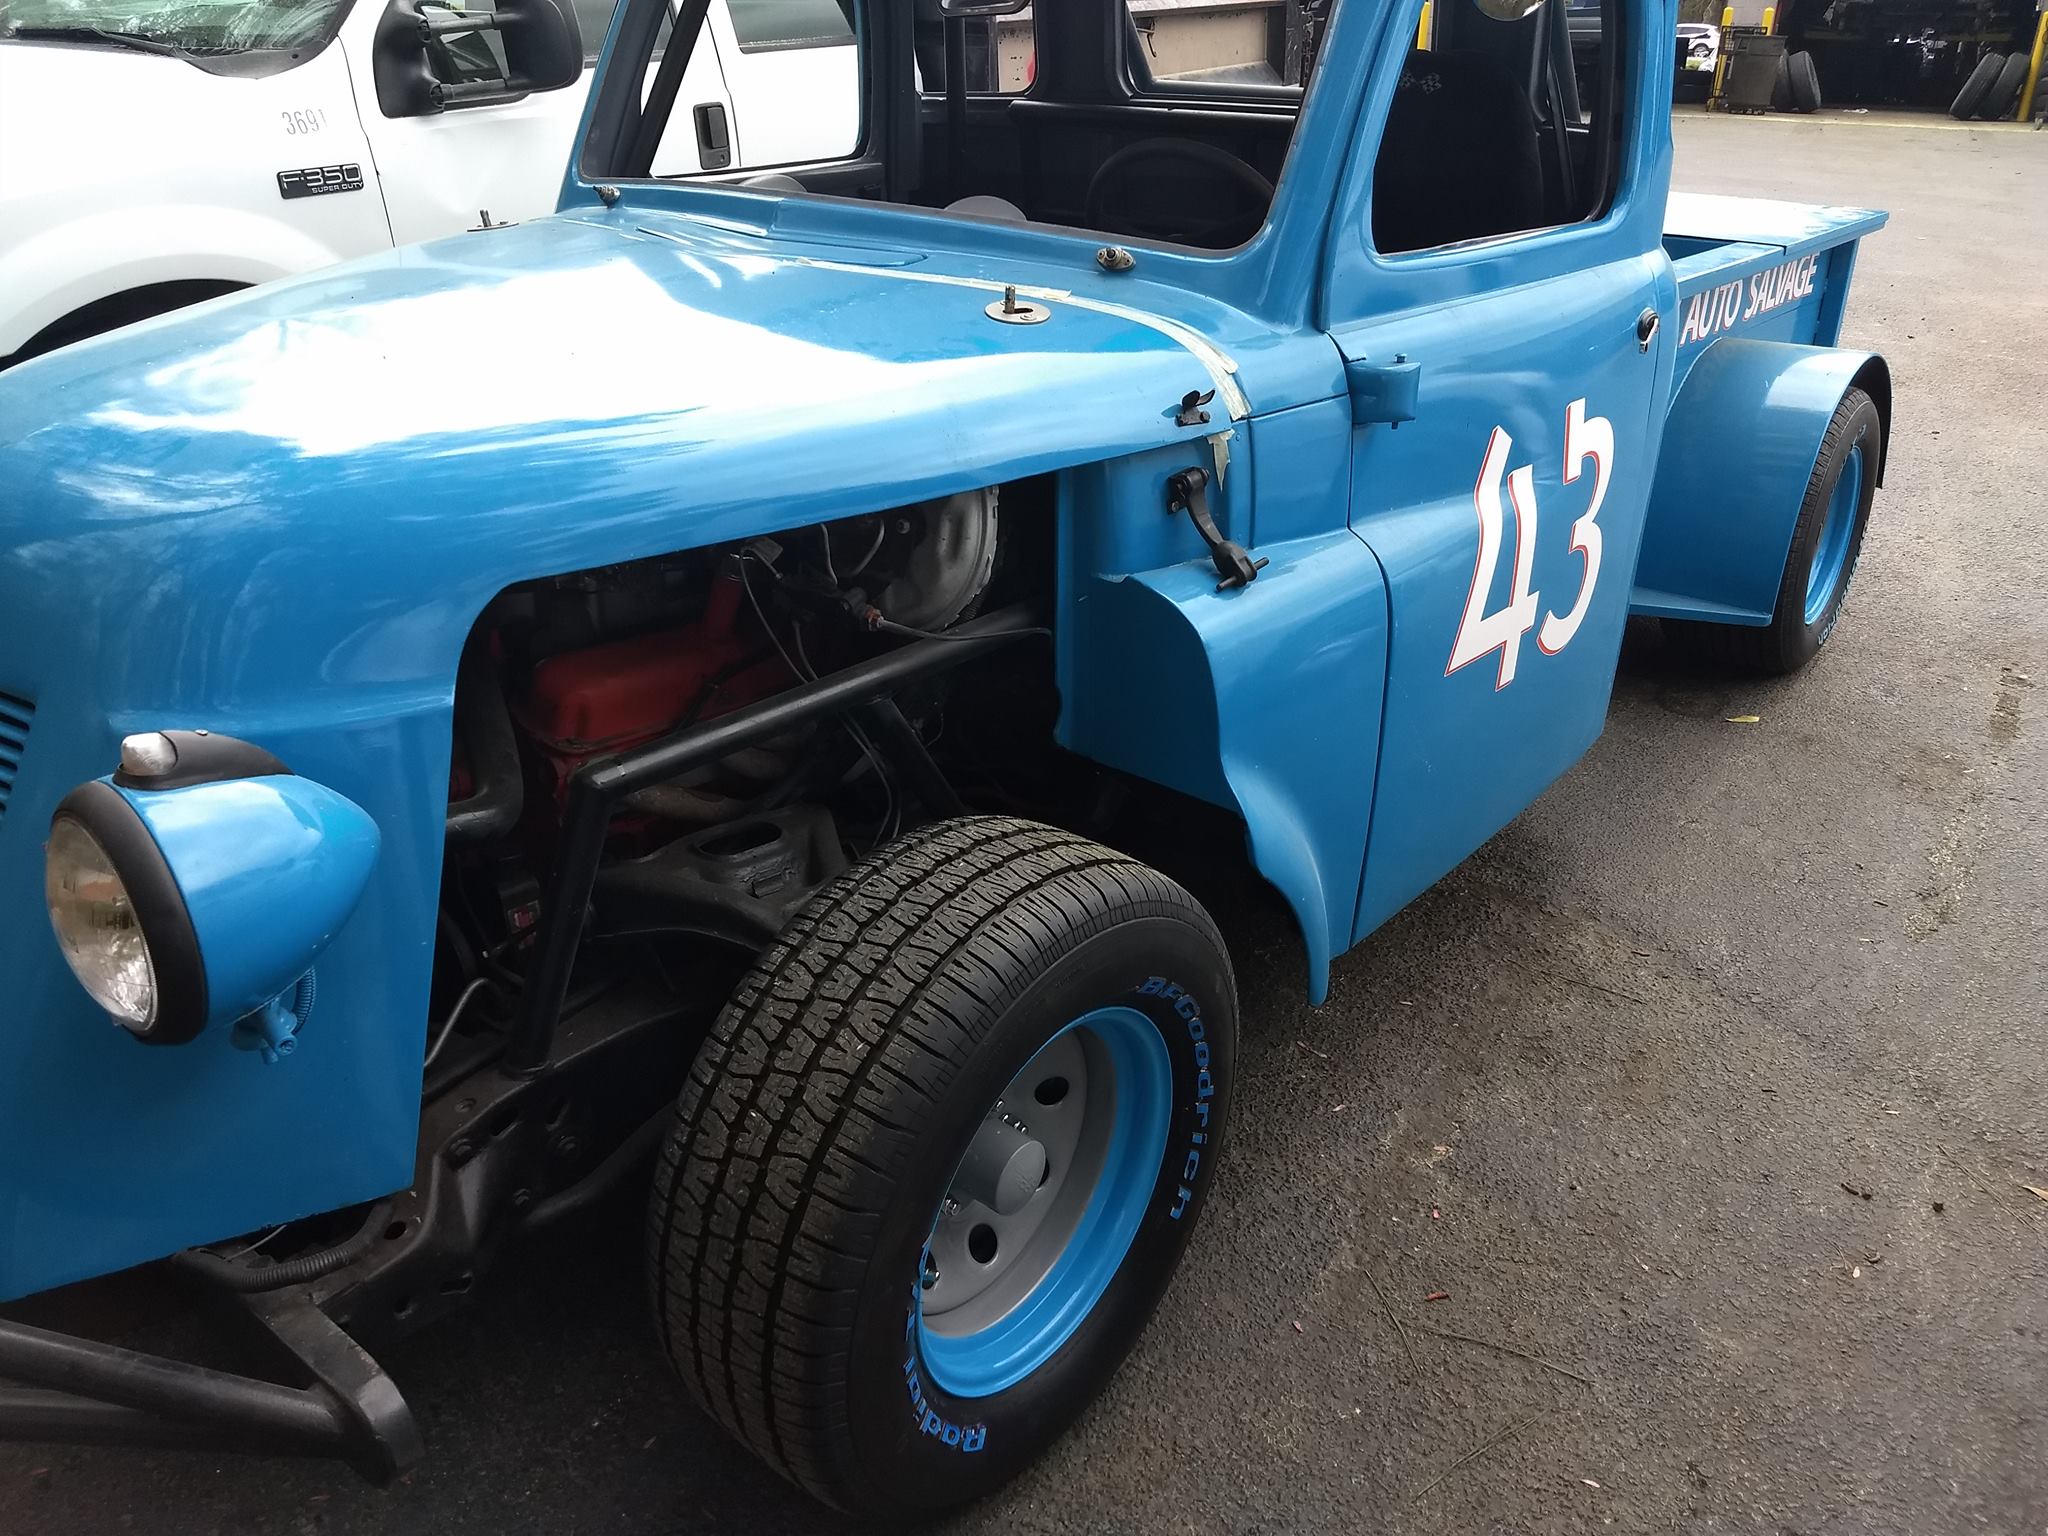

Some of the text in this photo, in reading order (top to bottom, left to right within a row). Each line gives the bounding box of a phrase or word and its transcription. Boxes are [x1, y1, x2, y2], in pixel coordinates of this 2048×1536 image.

[281, 108, 328, 135] 3691
[312, 181, 364, 194] SUPER DUTY
[1679, 252, 1821, 348] AUTO SALVAGE
[1444, 397, 1614, 692] 43
[903, 1355, 987, 1452] Radial
